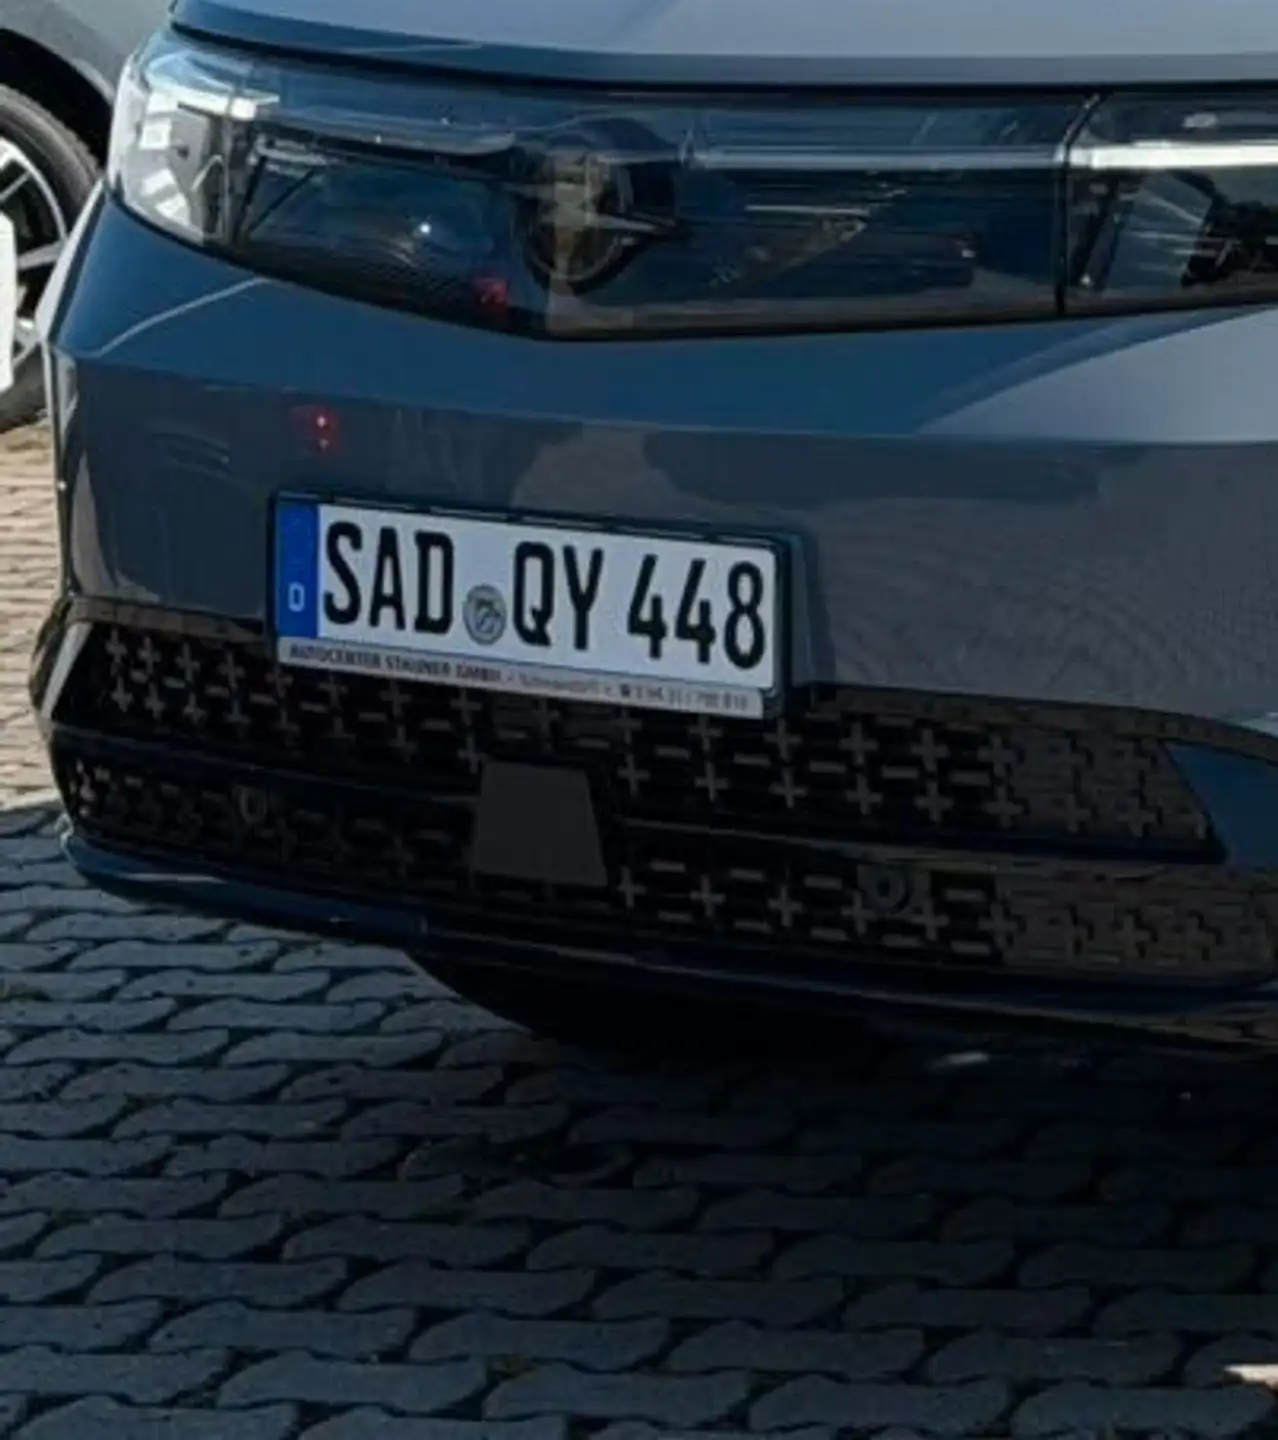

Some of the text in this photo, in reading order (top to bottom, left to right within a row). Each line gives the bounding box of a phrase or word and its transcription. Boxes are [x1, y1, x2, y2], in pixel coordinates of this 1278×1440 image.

[289, 581, 305, 612] D
[323, 521, 766, 670] SAD QY 448
